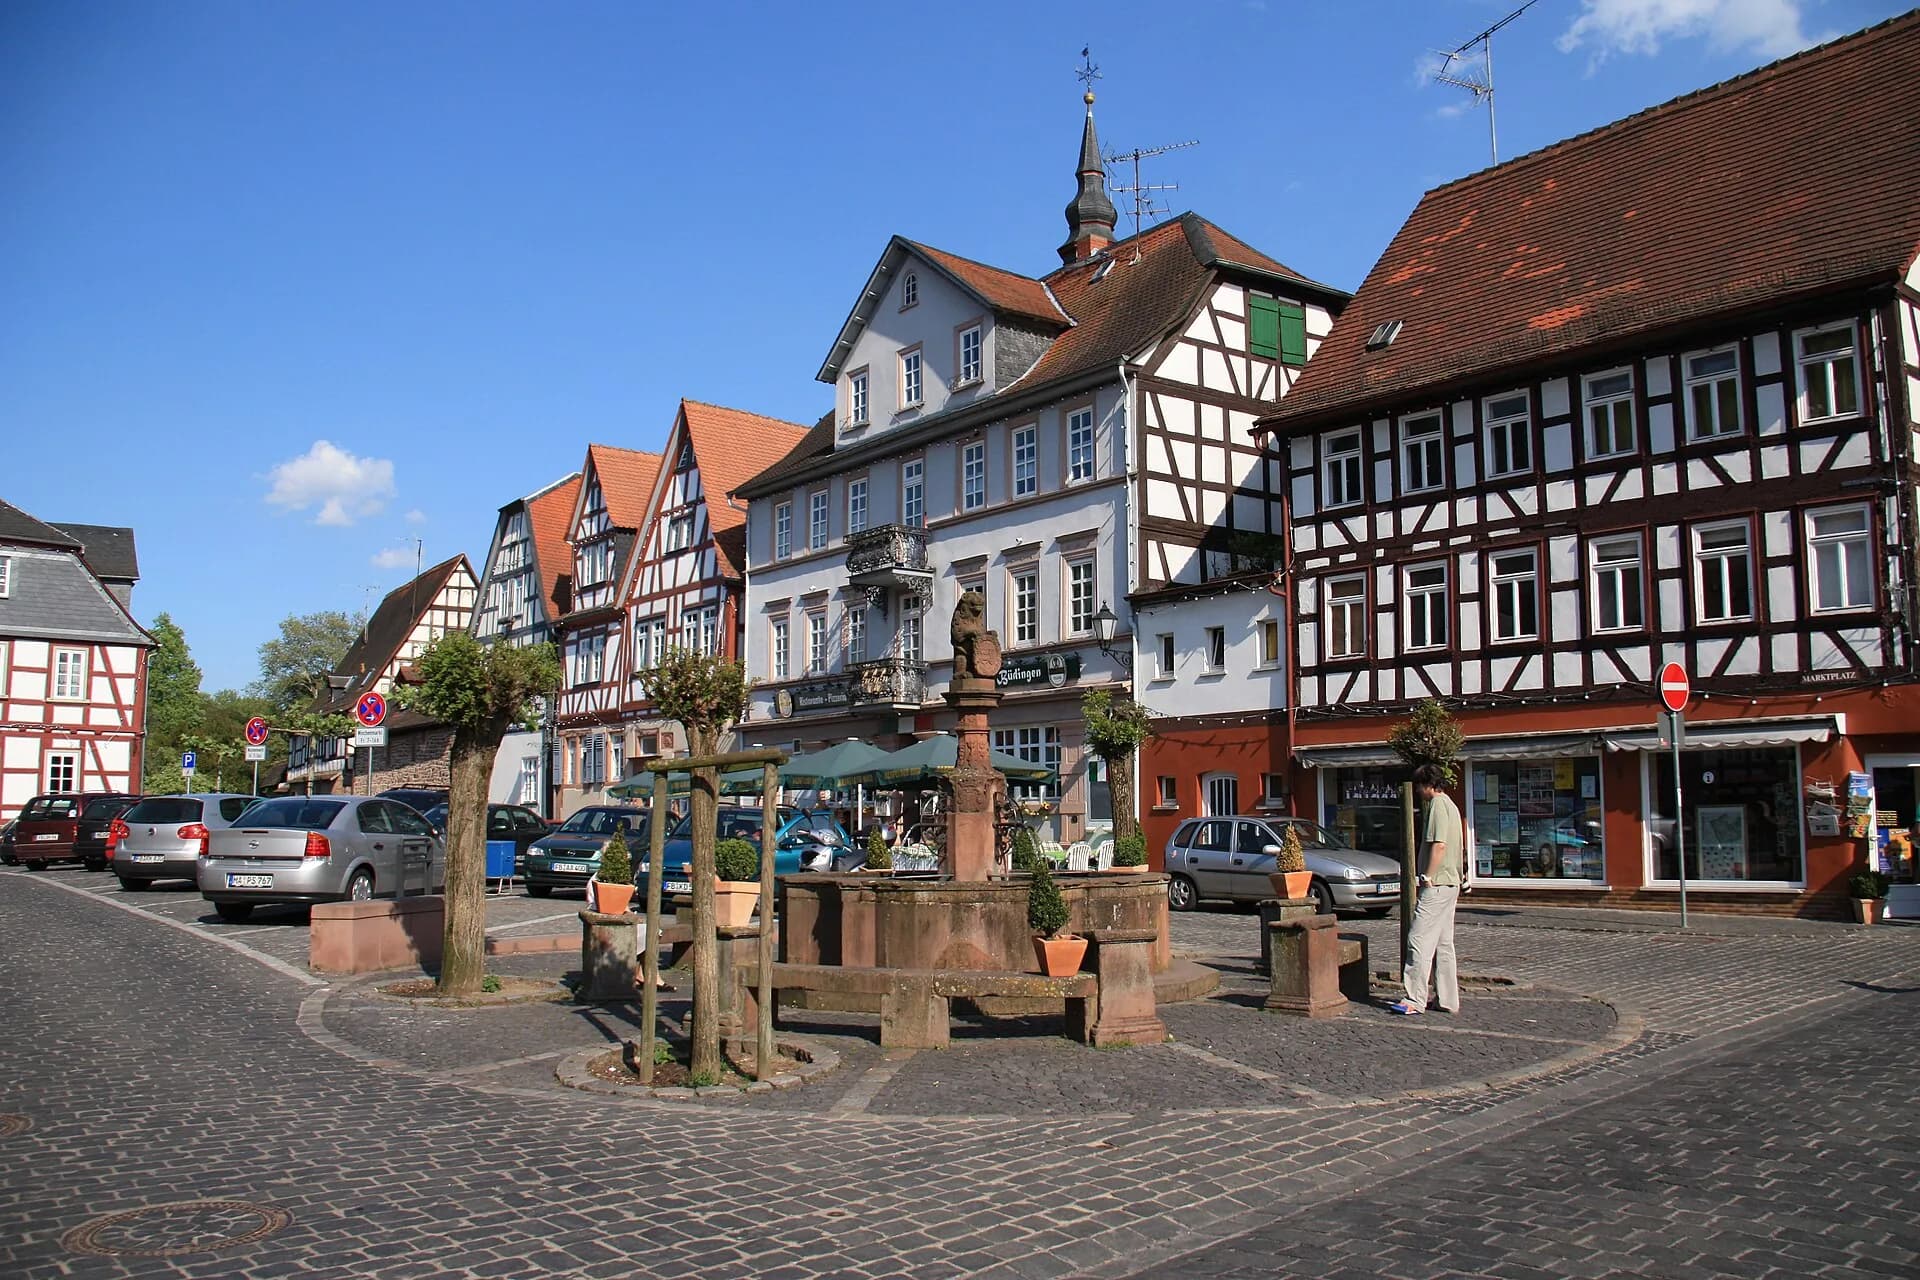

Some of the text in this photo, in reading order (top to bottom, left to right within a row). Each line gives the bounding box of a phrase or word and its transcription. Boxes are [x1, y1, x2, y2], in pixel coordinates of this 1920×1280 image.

[996, 667, 1042, 686] Büdingen
[1802, 671, 1857, 682] MARKTPLATZ
[185, 755, 193, 767] P
